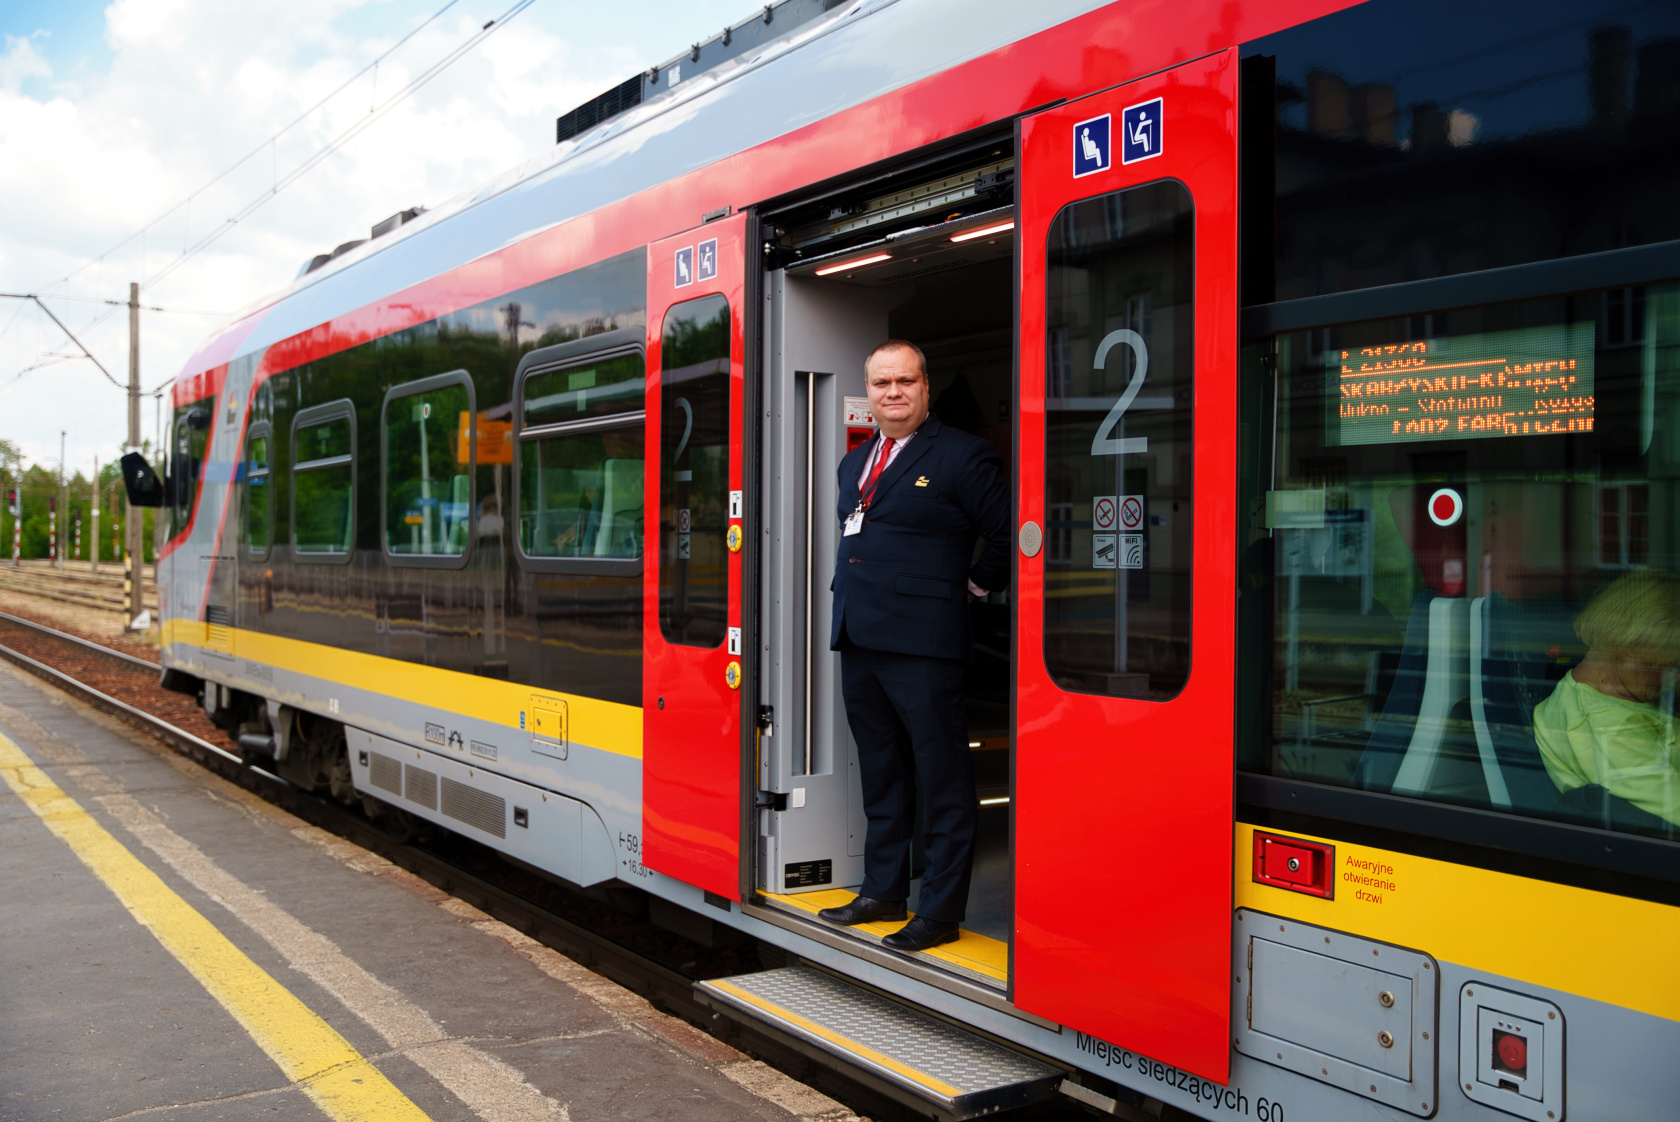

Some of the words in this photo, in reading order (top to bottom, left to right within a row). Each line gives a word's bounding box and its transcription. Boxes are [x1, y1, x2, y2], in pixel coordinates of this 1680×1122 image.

[1091, 329, 1148, 455] 2
[674, 397, 692, 481] 2
[1346, 855, 1393, 875] Awaryjne
[1343, 872, 1396, 892] otwieranie
[1355, 889, 1382, 905] drzwi
[1257, 1097, 1284, 1122] 60
